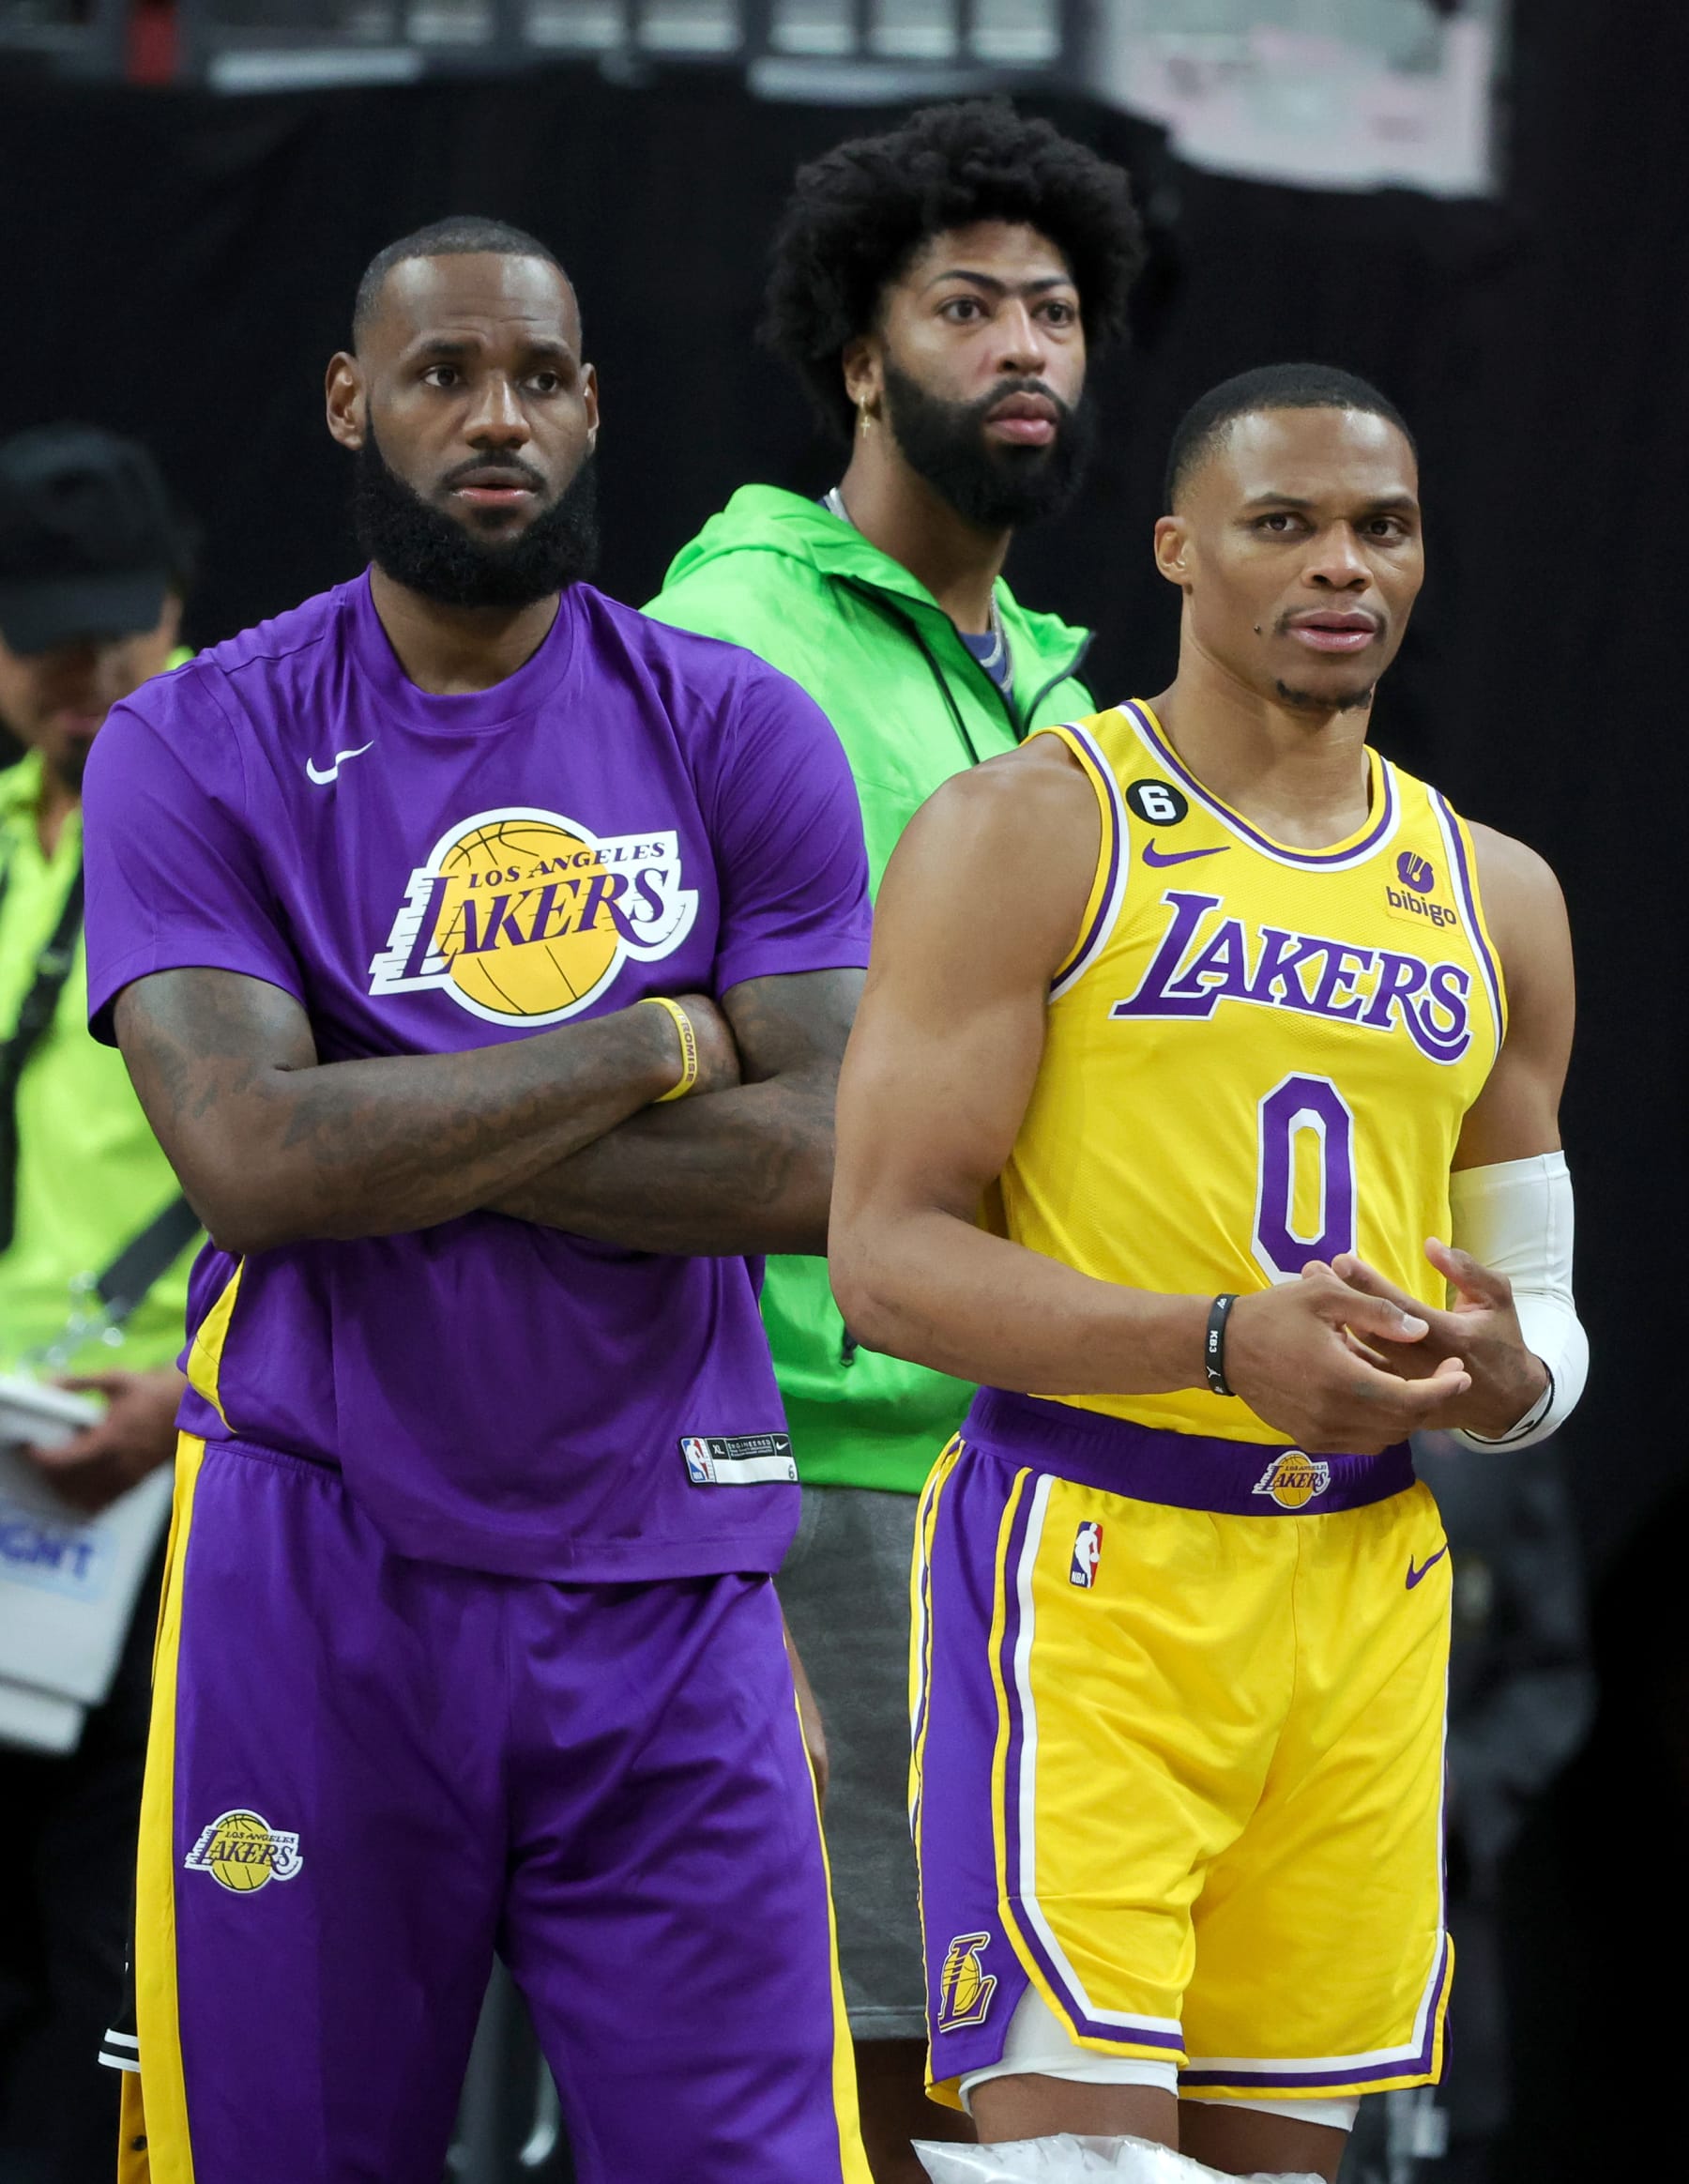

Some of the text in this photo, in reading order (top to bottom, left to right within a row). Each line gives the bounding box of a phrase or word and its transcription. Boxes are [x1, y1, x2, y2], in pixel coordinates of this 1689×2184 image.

[1137, 785, 1175, 821] 6
[469, 841, 665, 889] LOS ANGELES
[386, 866, 685, 982] LAKERS
[1386, 886, 1456, 927] bibigo
[1108, 890, 1474, 1066] LAKERS
[1250, 1071, 1358, 1287] 0
[1209, 1330, 1219, 1353] KB3
[712, 1443, 725, 1455] XL
[787, 1465, 796, 1480] 6
[1257, 1465, 1329, 1493] LAKERS
[1071, 1571, 1086, 1585] NBA
[190, 1829, 298, 1875] LAKERS
[225, 1831, 295, 1843] LOS ANGELES
